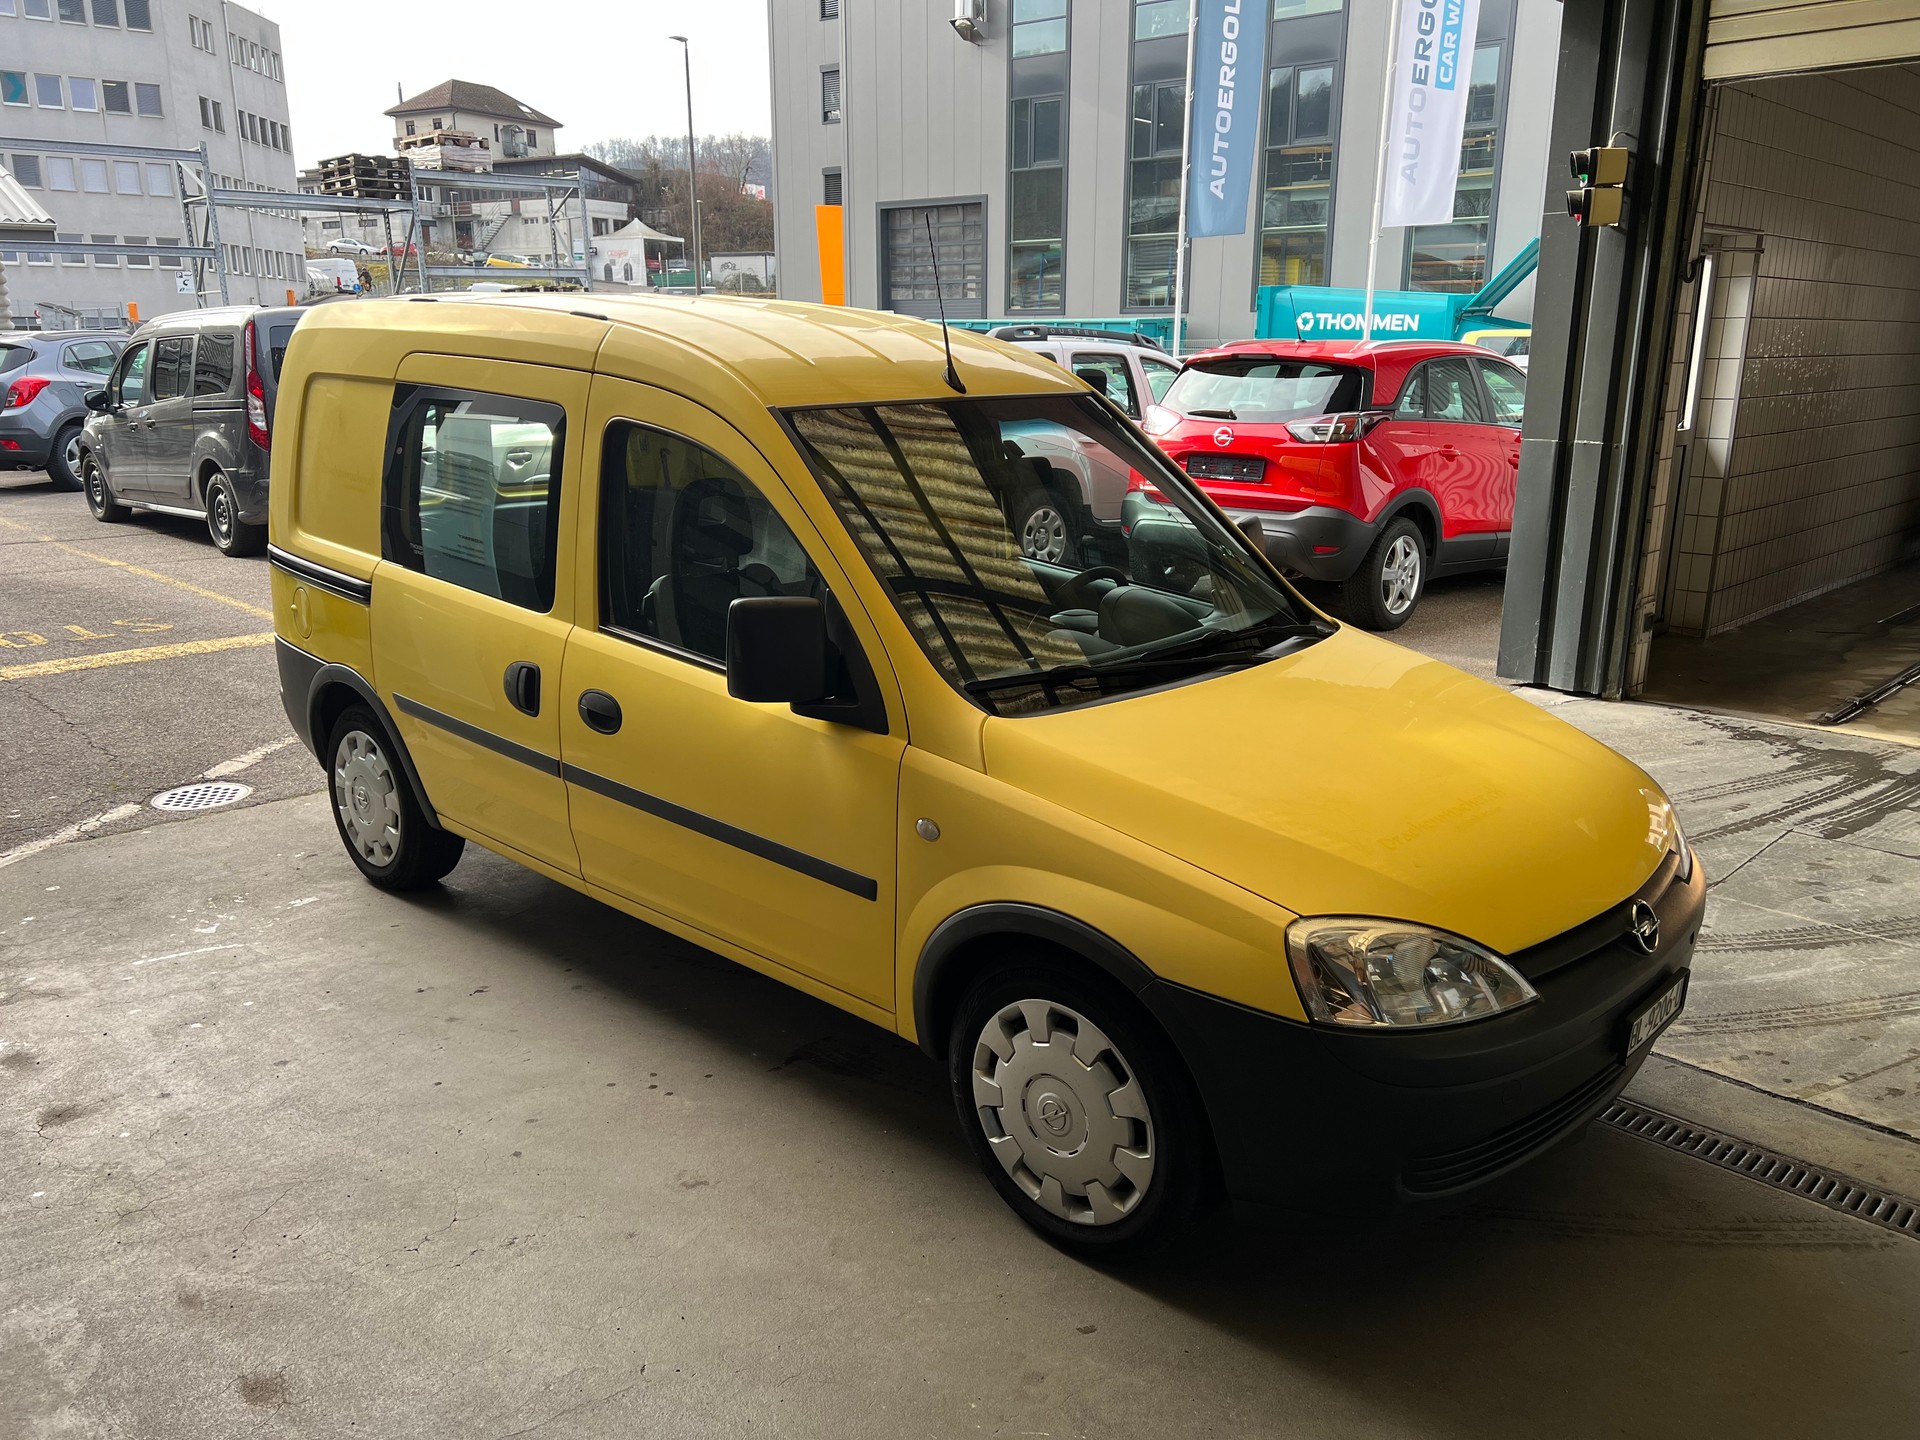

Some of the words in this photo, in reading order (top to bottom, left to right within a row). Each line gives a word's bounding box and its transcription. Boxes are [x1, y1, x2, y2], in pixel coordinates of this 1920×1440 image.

[1446, 0, 1463, 26] W
[1440, 32, 1457, 83] CAR
[1210, 0, 1241, 200] AUTOERGOL
[1050, 328, 1098, 336] DUSTER
